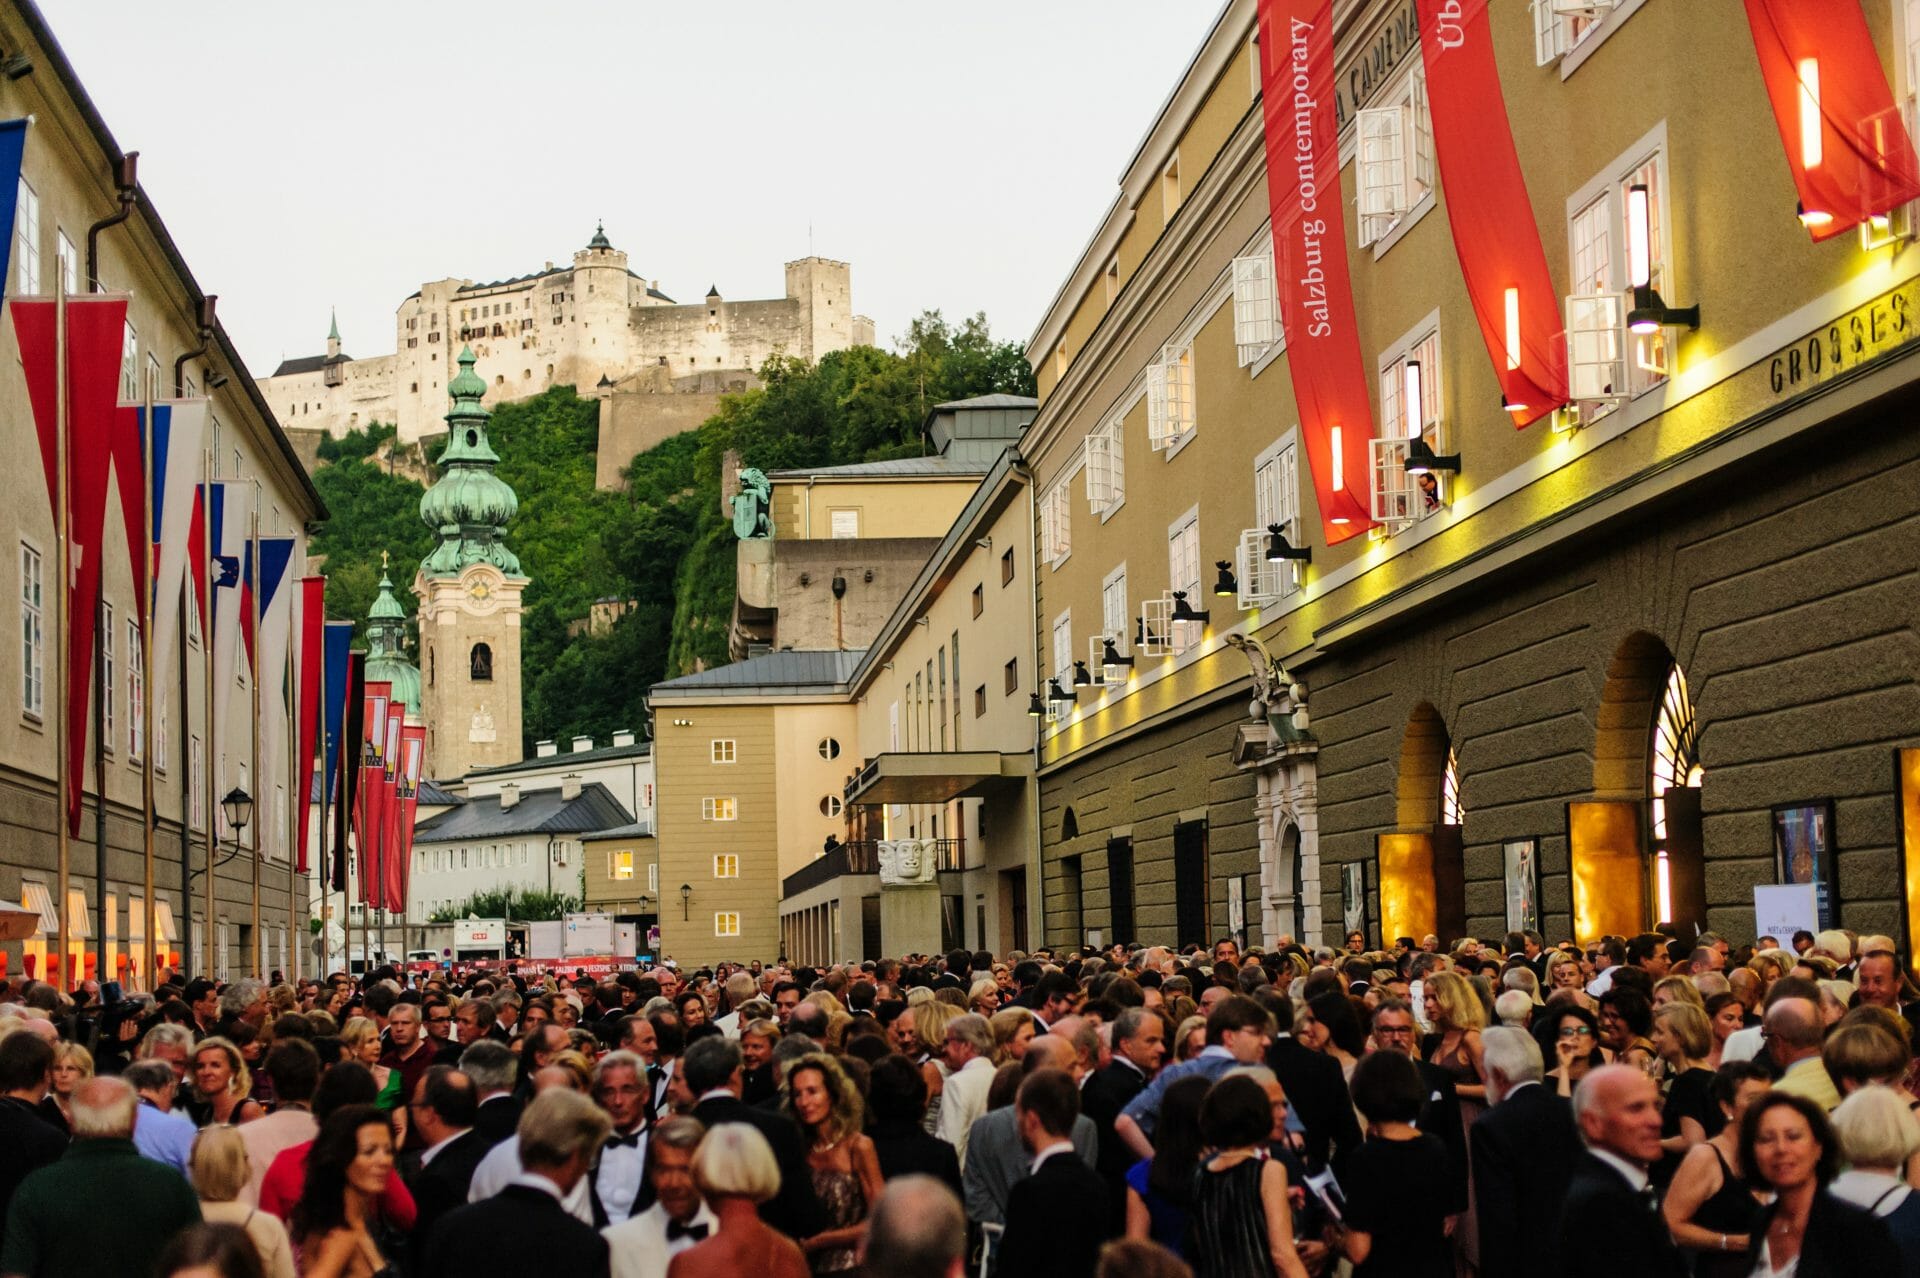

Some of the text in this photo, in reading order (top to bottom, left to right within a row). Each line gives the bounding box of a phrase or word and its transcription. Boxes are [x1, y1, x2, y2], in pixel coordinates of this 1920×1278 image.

[1291, 16, 1331, 338] Salzburg contemporary
[1770, 293, 1906, 394] GROSSES
